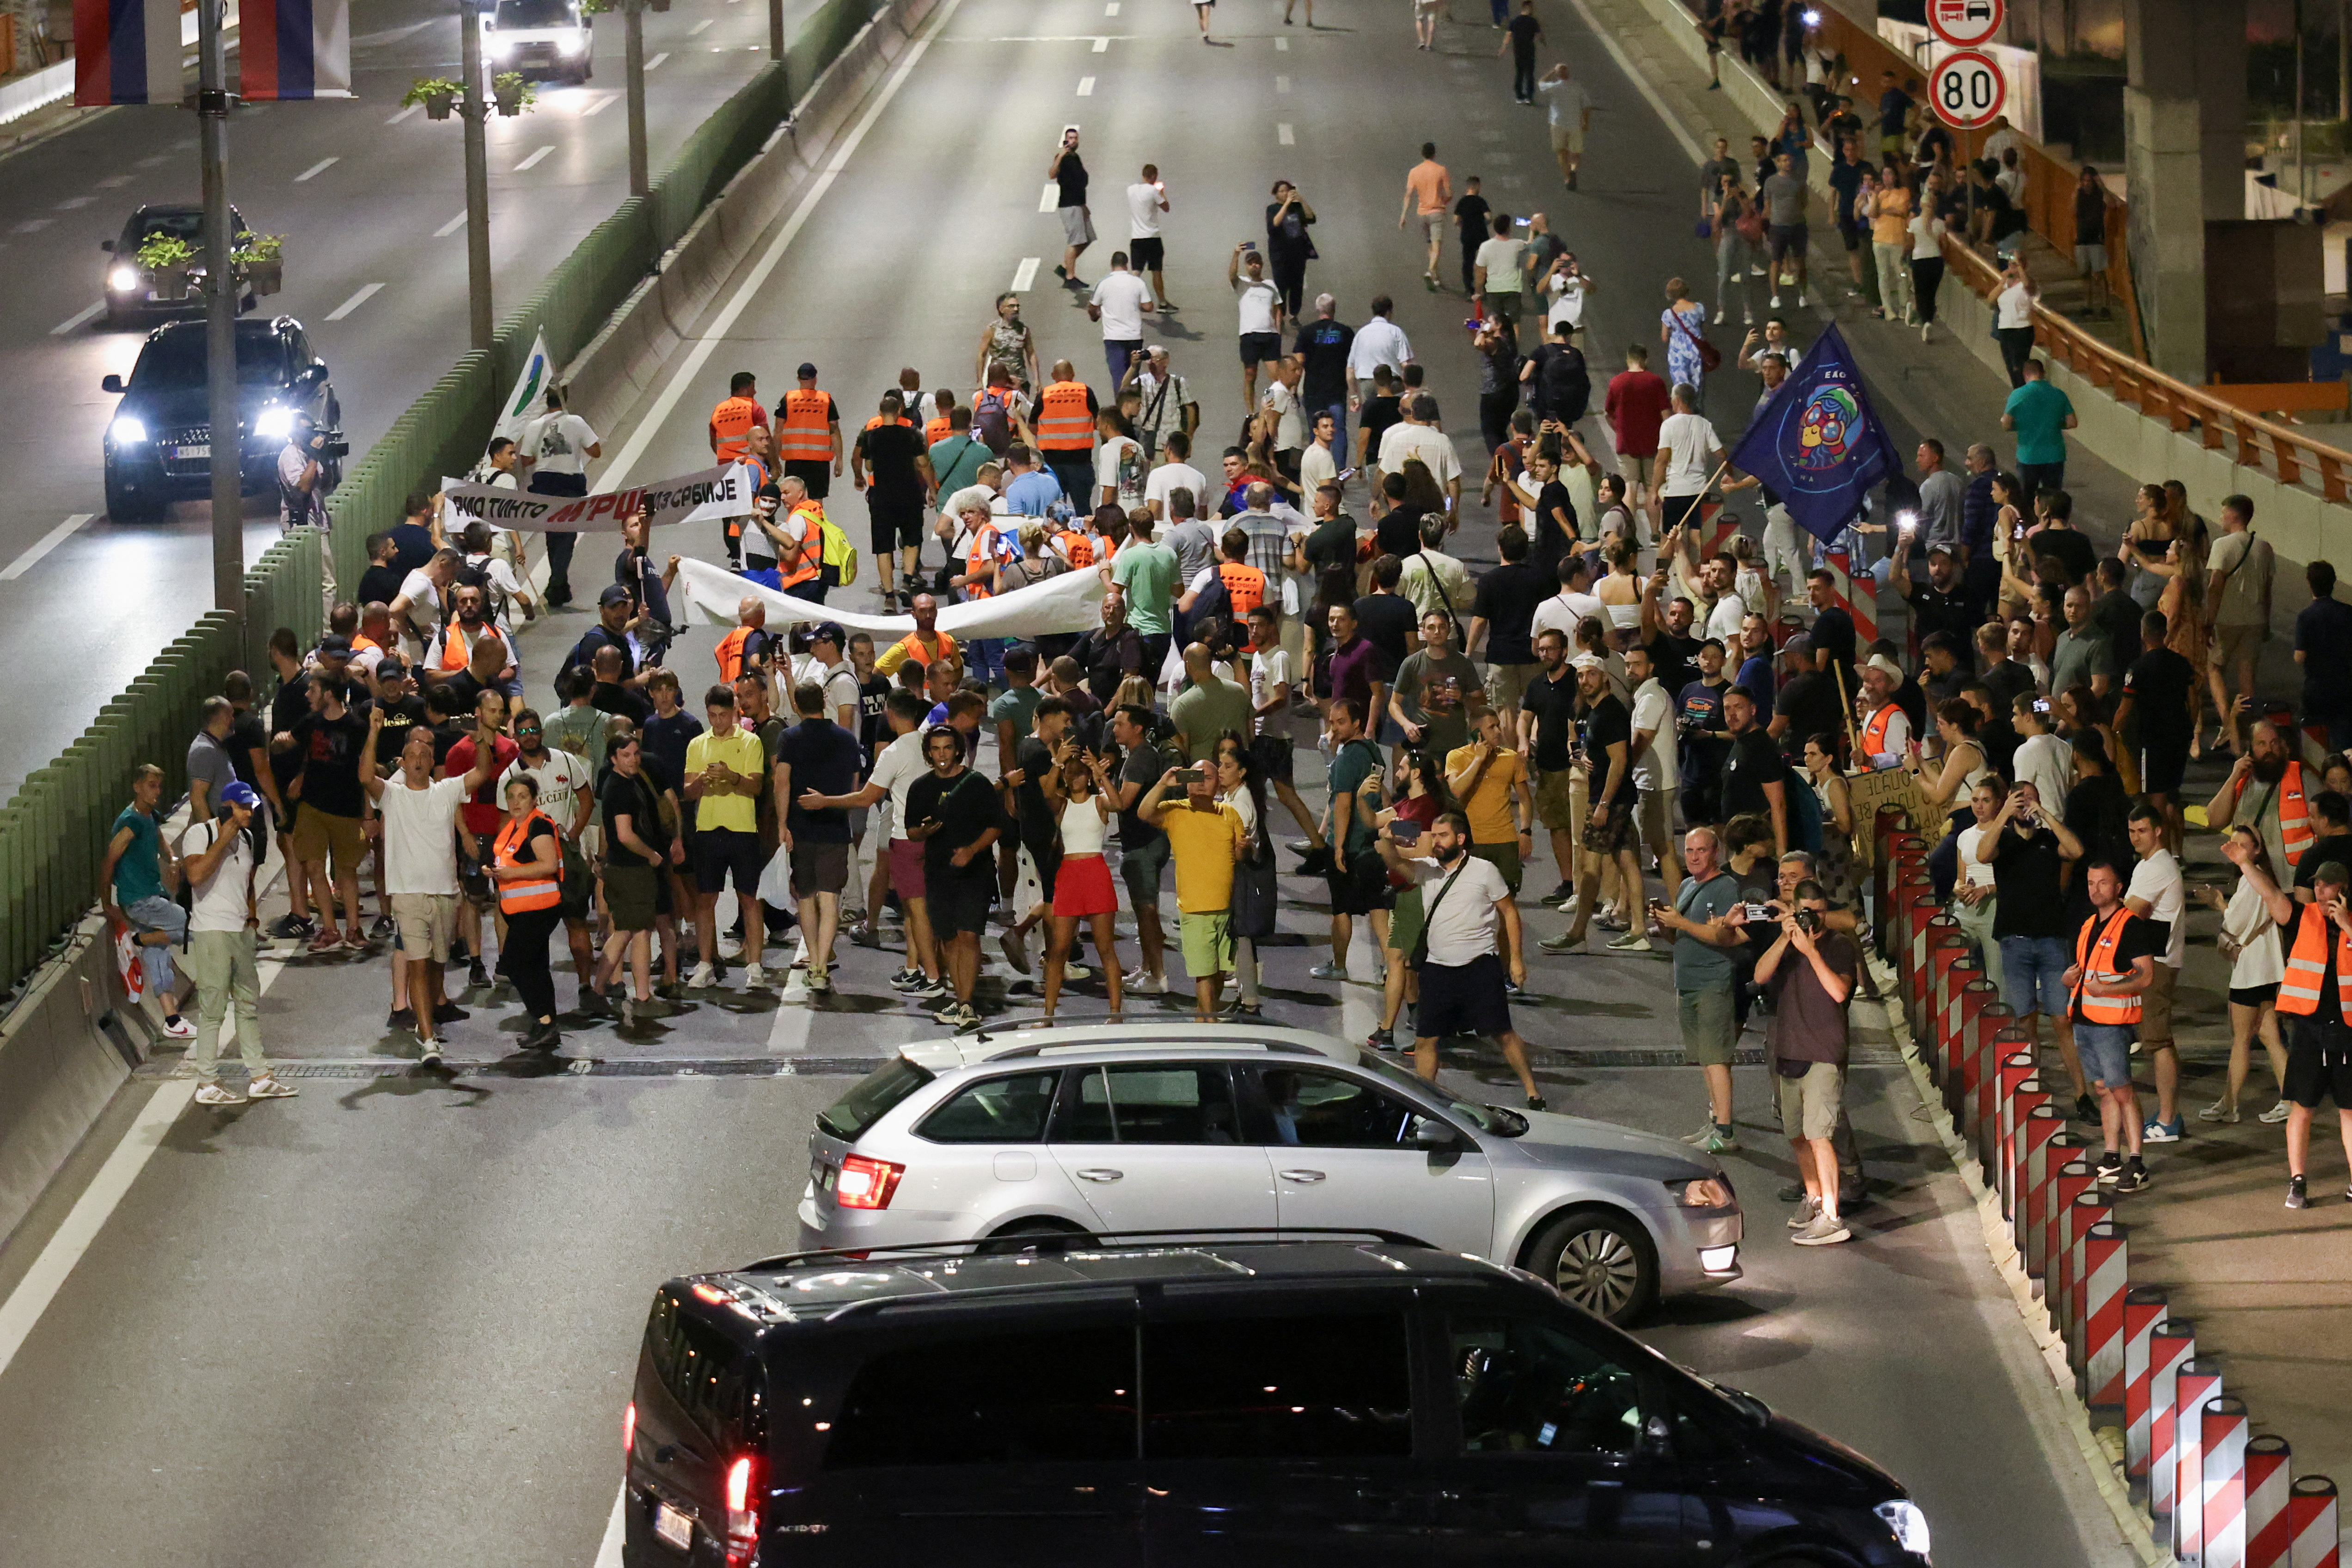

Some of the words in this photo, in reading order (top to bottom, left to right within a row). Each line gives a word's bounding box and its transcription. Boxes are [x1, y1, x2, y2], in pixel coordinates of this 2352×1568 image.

[1944, 70, 1991, 110] 80
[453, 496, 486, 518] РИО
[489, 497, 549, 518] ТИНТО
[670, 478, 737, 508] СРБИЈЕ
